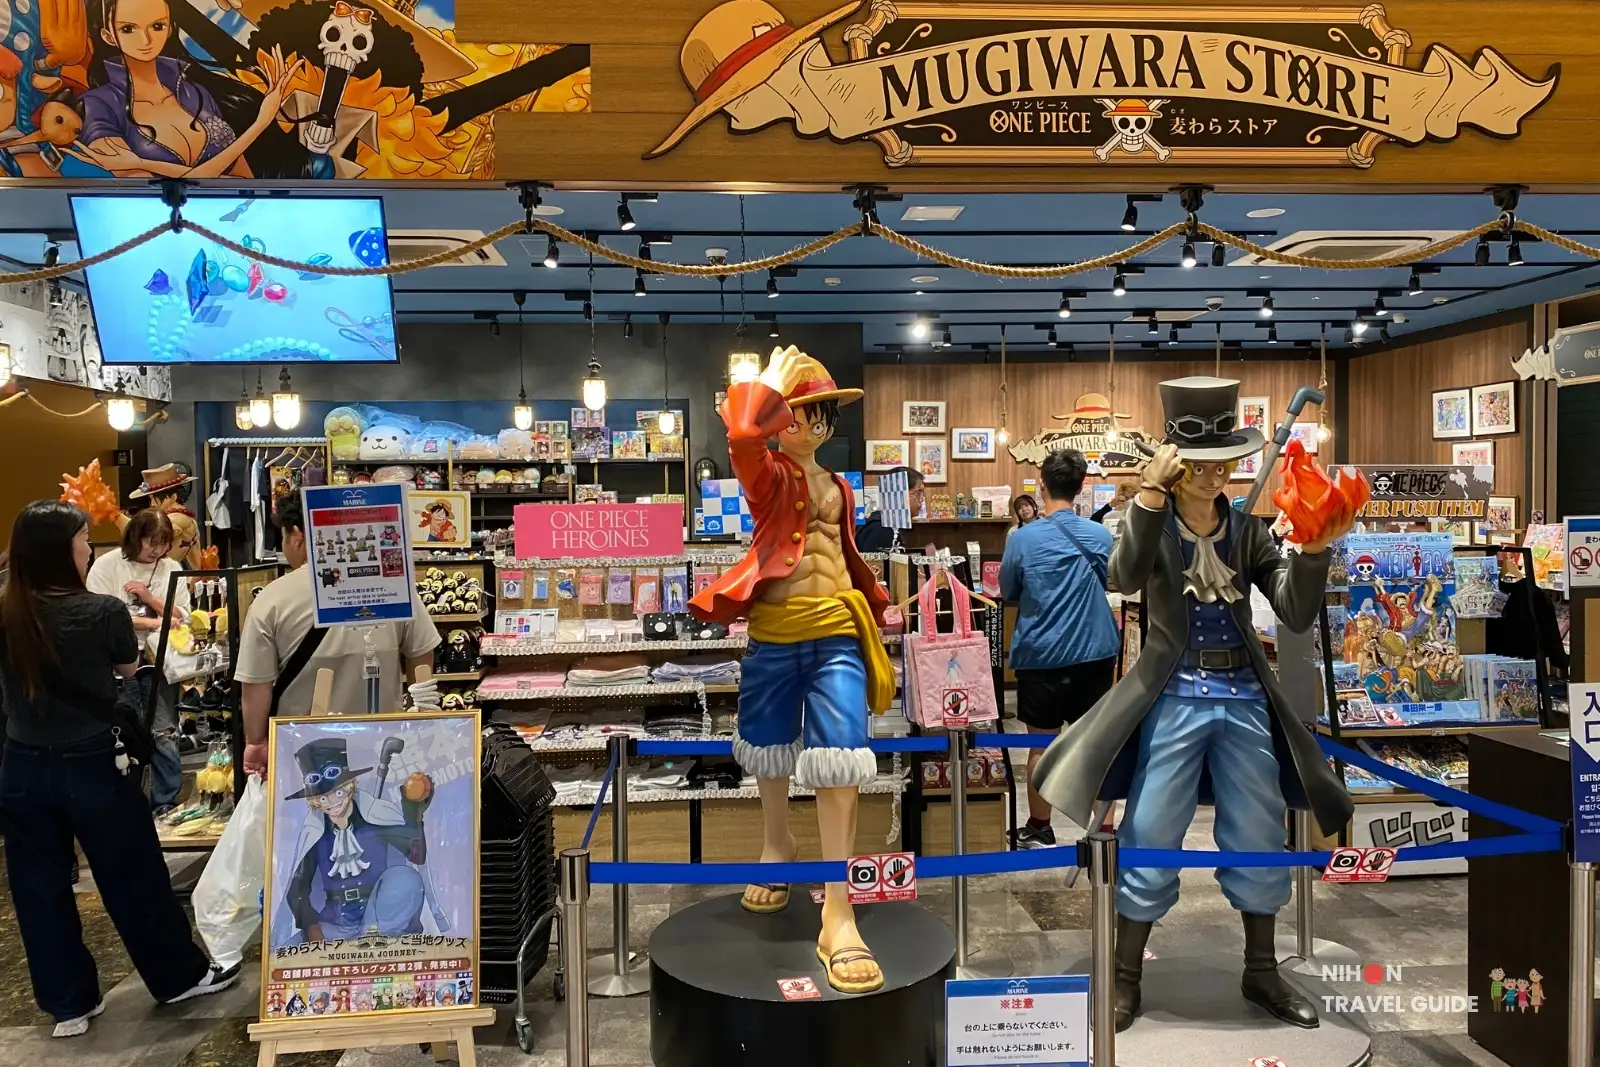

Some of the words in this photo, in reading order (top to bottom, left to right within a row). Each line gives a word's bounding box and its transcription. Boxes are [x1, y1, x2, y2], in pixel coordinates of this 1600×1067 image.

[878, 32, 1206, 121] MUGIWARA
[1225, 40, 1391, 126] STORE
[1012, 100, 1069, 110] ワンピース
[989, 109, 1034, 133] ONE
[1040, 111, 1092, 133] PIECE
[1169, 116, 1279, 135] 麦わらストア
[1072, 423, 1091, 433] ONE
[1391, 499, 1440, 517] PUSH
[1441, 499, 1485, 517] ITEM
[550, 511, 594, 529] ONE
[599, 510, 649, 528] PIECE
[551, 528, 649, 551] HEROINES
[275, 938, 345, 960] 麦わらストア
[400, 934, 468, 949] ご当地グッズ
[964, 1021, 1068, 1033] 台の上に乗らないでください。
